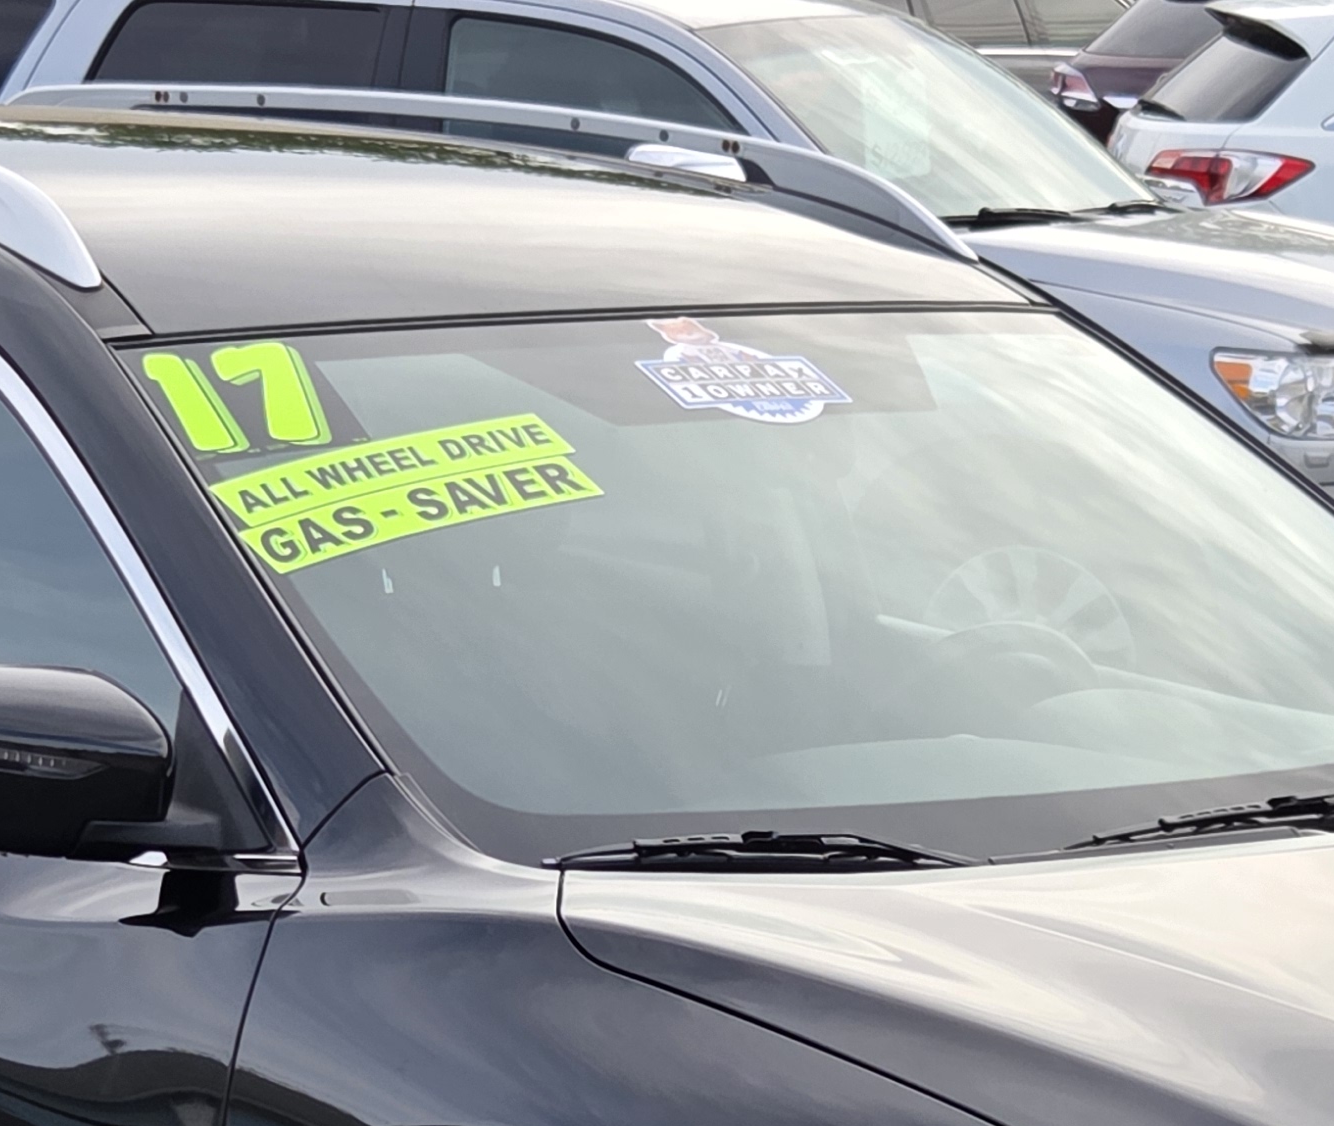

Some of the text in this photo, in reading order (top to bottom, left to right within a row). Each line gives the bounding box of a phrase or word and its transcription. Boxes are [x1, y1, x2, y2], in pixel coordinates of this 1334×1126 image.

[142, 341, 333, 454] 17
[705, 379, 831, 399] OWNER
[237, 422, 552, 515] ALL WHEEL DRIVE
[260, 505, 376, 564] GAS
[406, 461, 587, 522] SAVER
